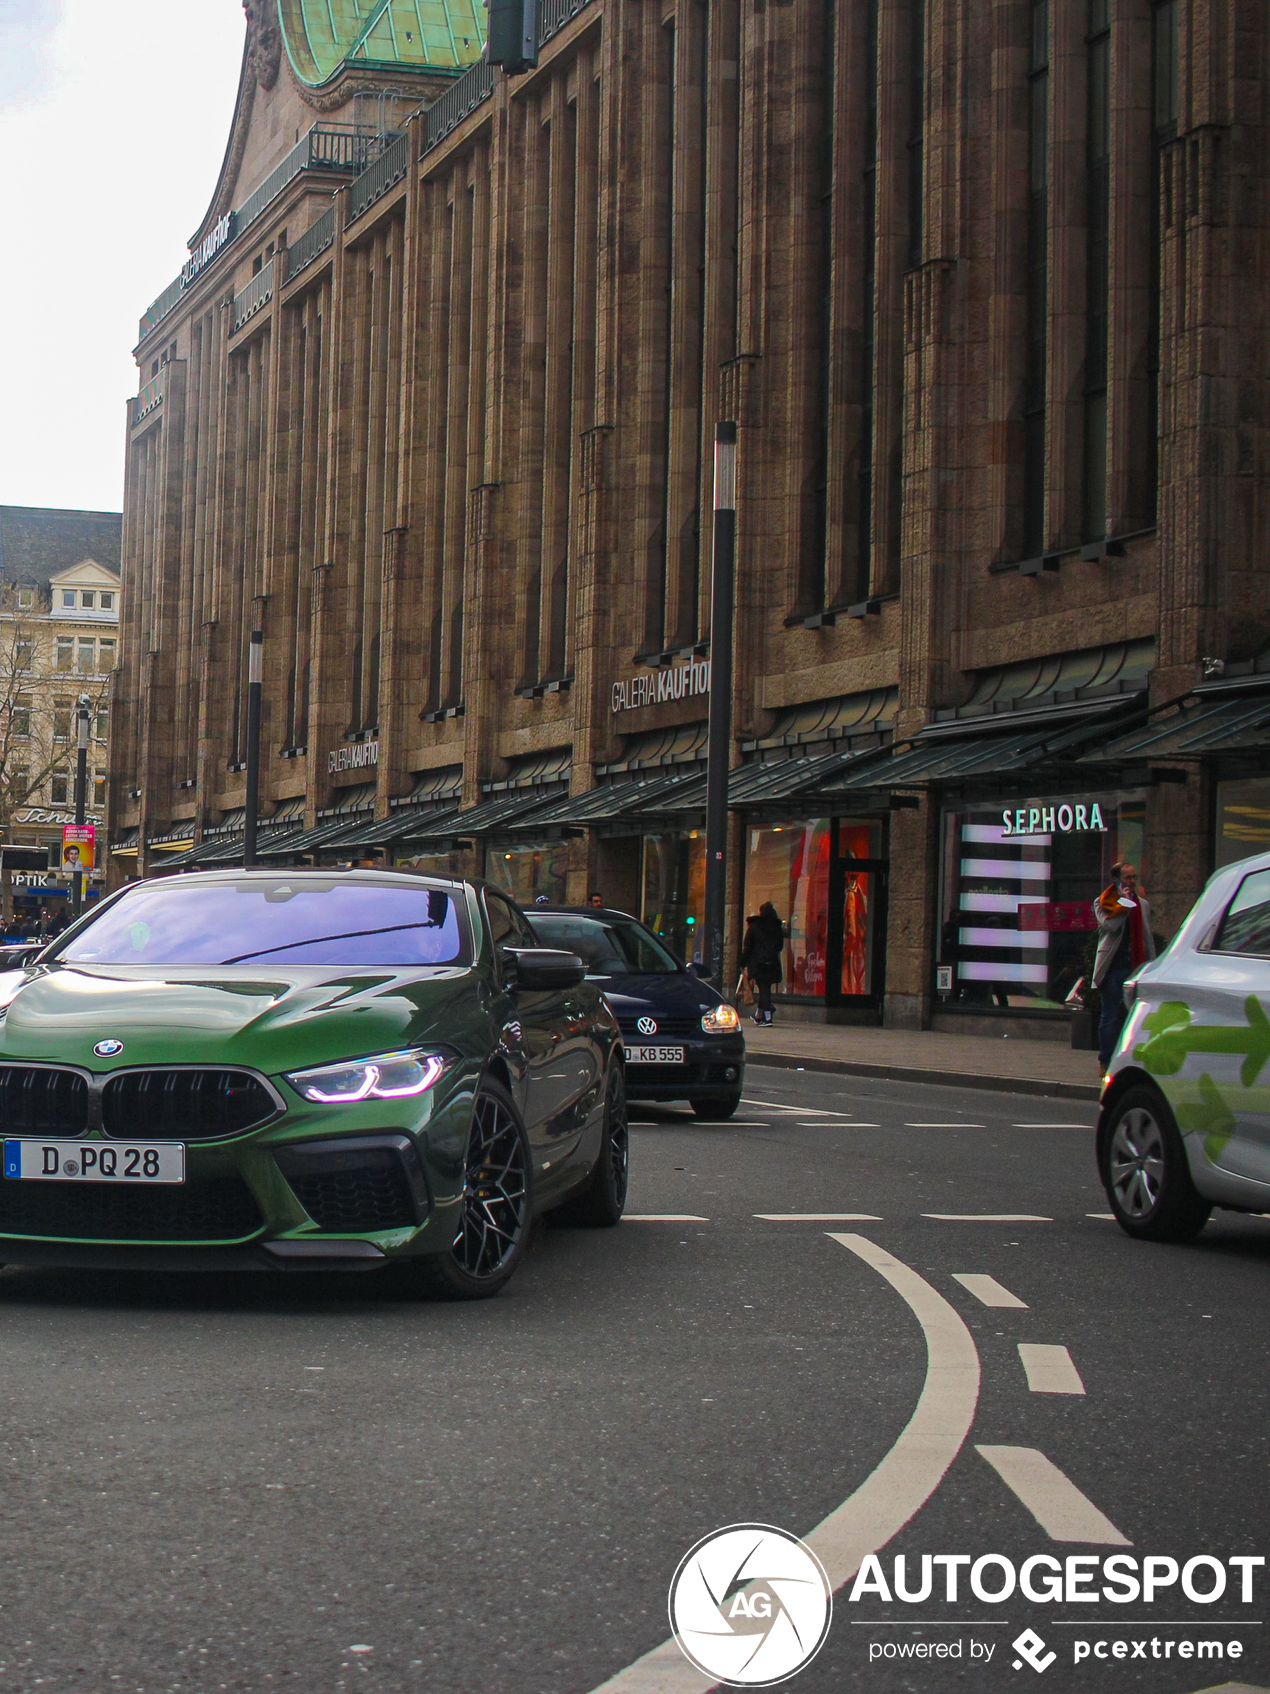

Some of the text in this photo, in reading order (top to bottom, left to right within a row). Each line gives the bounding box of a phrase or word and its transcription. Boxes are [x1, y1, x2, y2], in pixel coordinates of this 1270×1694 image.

[611, 674, 656, 713] GALERIA
[328, 746, 352, 773] GALERIA
[1002, 803, 1104, 835] SEPHORA
[624, 1048, 683, 1061] D KB 555
[10, 1163, 17, 1172] D
[41, 1146, 160, 1178] D PQ 28
